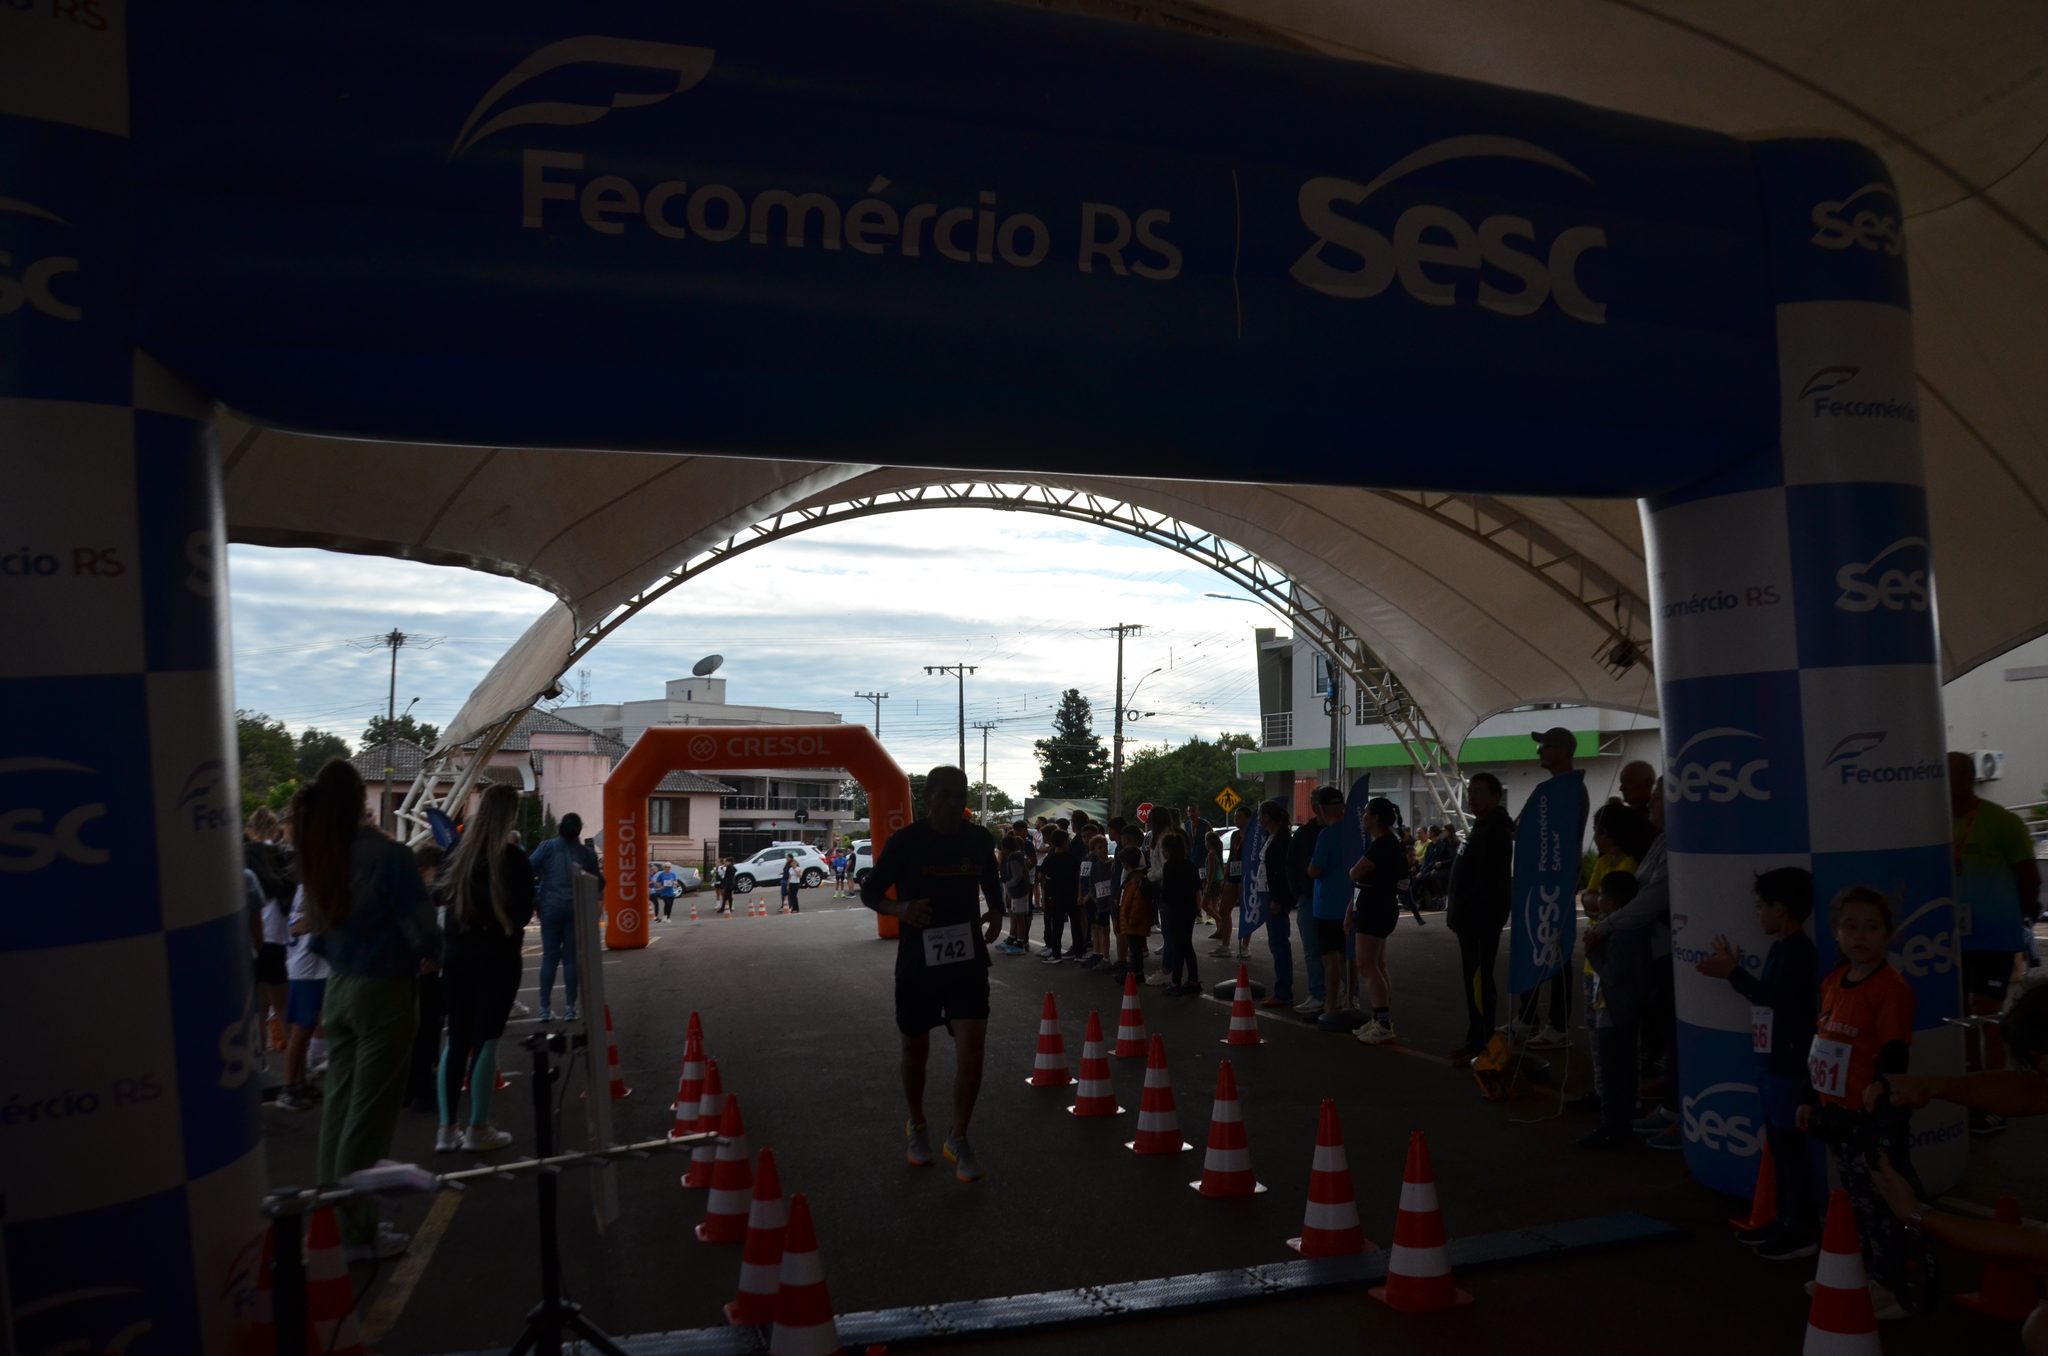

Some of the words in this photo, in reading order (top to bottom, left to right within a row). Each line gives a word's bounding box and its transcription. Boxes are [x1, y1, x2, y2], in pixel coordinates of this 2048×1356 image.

[522, 148, 1050, 268] Fecomércio
[1078, 201, 1183, 281] RS
[1810, 201, 1902, 256] Ses
[1288, 175, 1607, 325] Sesc
[73, 547, 125, 577] RS
[1834, 562, 1929, 613] Ses
[1664, 591, 1739, 619] omércio
[1746, 585, 1781, 608] RS
[726, 735, 831, 758] CRESOL
[617, 811, 637, 902] CRESOL
[1538, 794, 1549, 872] Fecomércio
[932, 940, 966, 961] 742
[1532, 885, 1562, 968] Sesc
[1, 1089, 99, 1126] ércio
[113, 1073, 162, 1107] RS
[1682, 1094, 1762, 1158] Ses
